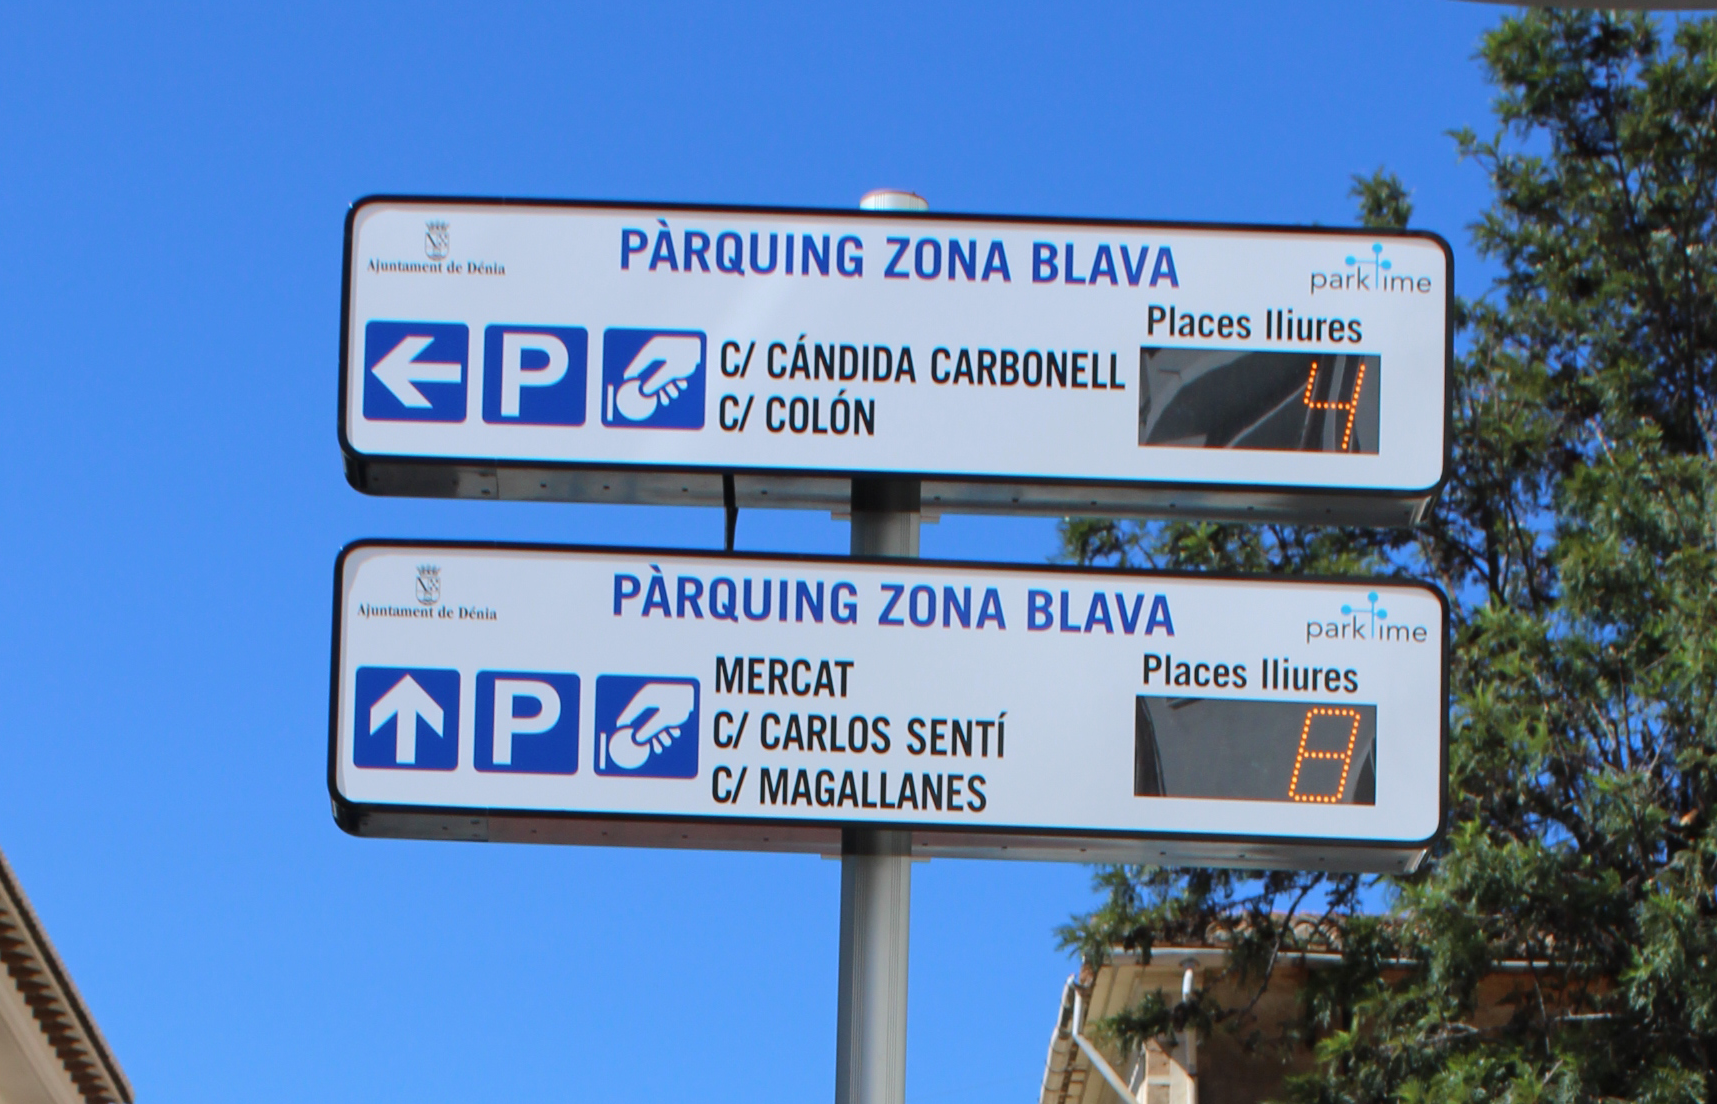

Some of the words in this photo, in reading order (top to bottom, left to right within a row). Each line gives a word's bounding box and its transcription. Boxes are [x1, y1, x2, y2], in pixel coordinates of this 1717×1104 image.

[367, 258, 443, 274] Ajuntament
[447, 259, 462, 275] de
[467, 259, 506, 275] Dénia
[620, 218, 864, 278] PÀRQUING
[884, 237, 1011, 283] ZONA
[1033, 241, 1179, 287] BLAVA
[1148, 304, 1251, 340] Places
[1266, 308, 1362, 344] lliures
[501, 332, 569, 417] P
[720, 340, 753, 378] C/
[767, 334, 913, 384] CÁNDIDA
[931, 346, 1126, 390] CARBONELL
[720, 393, 753, 432] C/
[766, 390, 875, 436] COLÓN
[1302, 360, 1367, 451] 4
[358, 603, 434, 619] Ajuntament
[438, 604, 454, 619] de
[459, 605, 497, 620] Dénia
[613, 564, 859, 624] PÀRQUING
[879, 583, 1006, 630] ZONA
[1028, 589, 1175, 636] BLAVA
[716, 655, 854, 698] MERCAT
[1144, 653, 1247, 689] Places
[1262, 657, 1358, 693] lliures
[493, 679, 560, 765] P
[713, 711, 748, 749] C/
[761, 713, 890, 754] CARLOS
[907, 711, 1006, 758] SENTÍ
[1288, 706, 1363, 804] 8
[711, 766, 747, 804] C/
[760, 767, 988, 813] MAGALLANES
